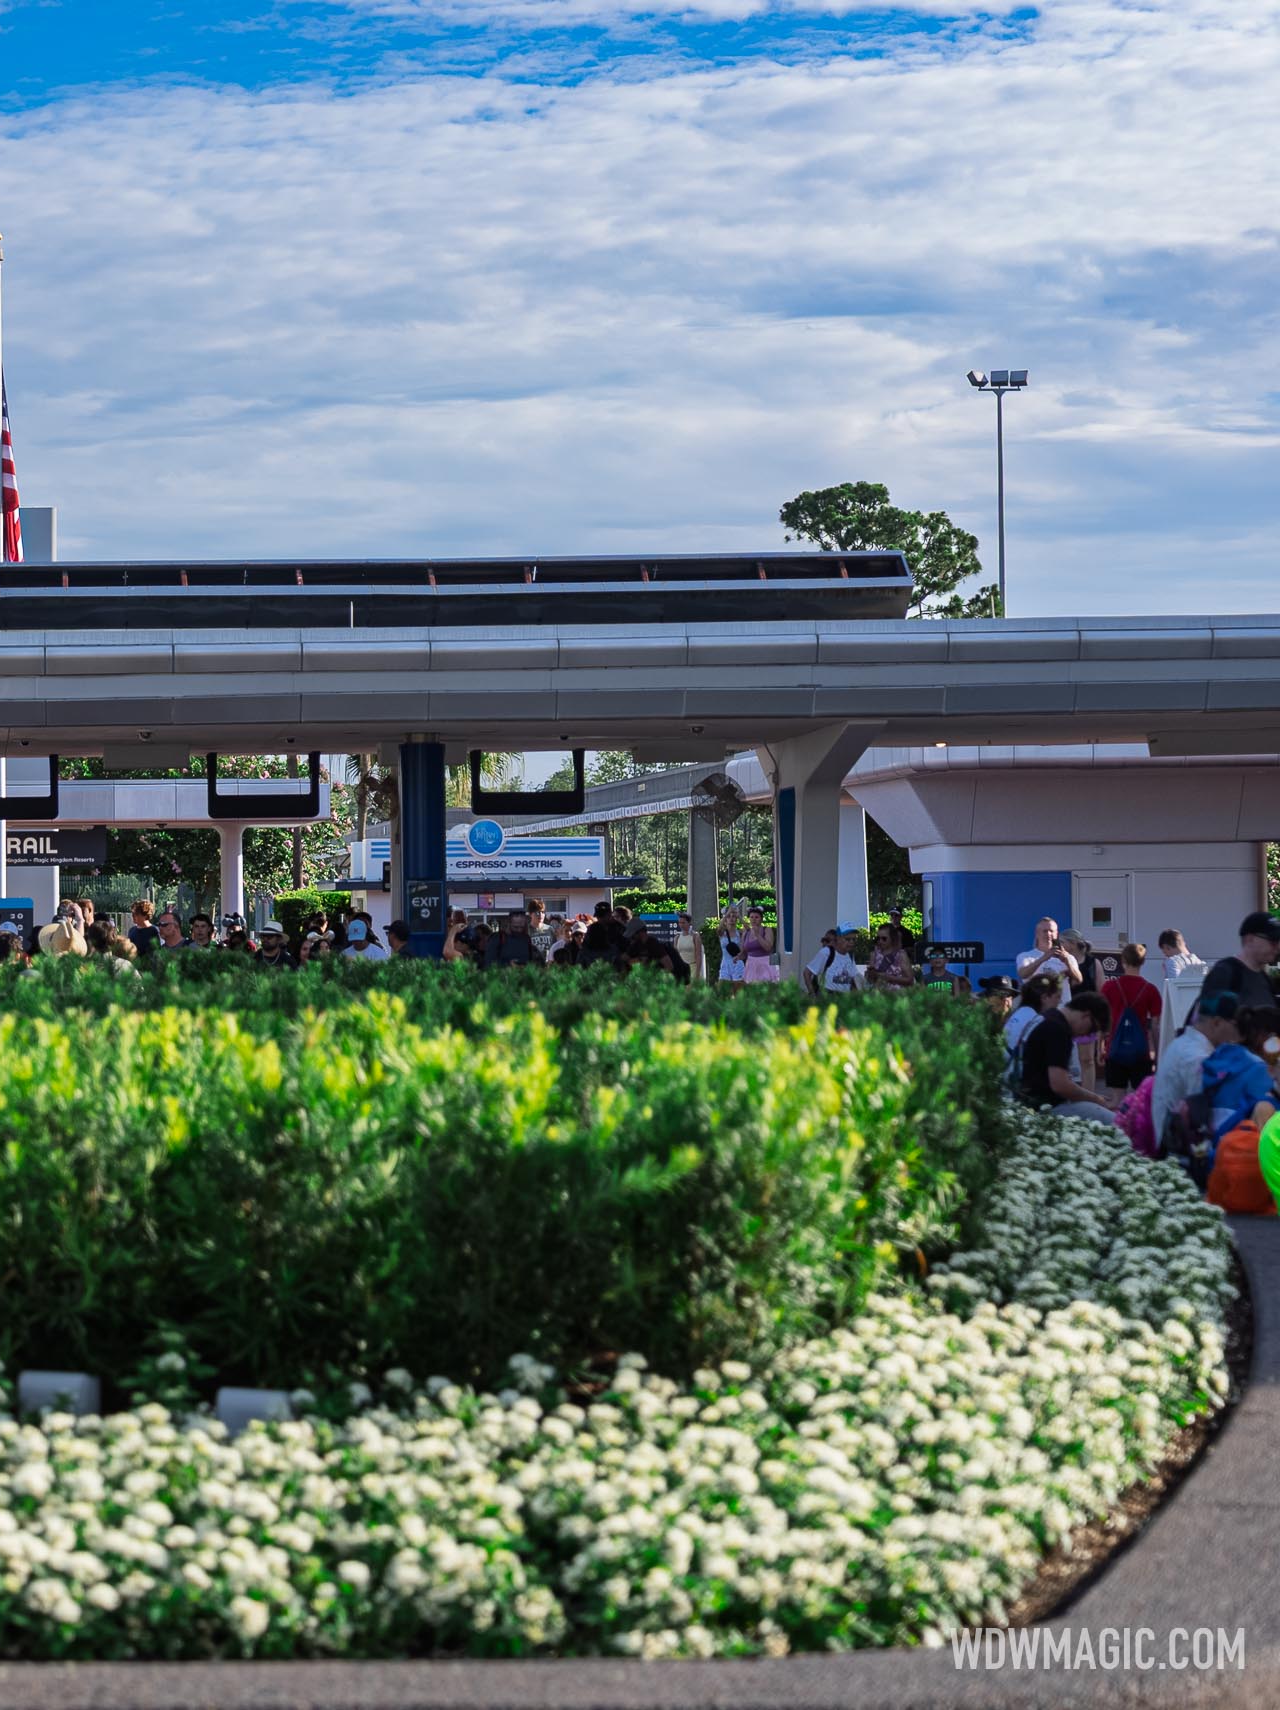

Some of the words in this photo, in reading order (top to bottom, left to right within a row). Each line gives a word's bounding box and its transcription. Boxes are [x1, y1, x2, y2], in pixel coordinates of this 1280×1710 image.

[456, 860, 507, 868] ESPRESSO
[515, 860, 562, 868] PASTRIES
[411, 897, 439, 907] EXIT
[944, 947, 976, 958] EXIT
